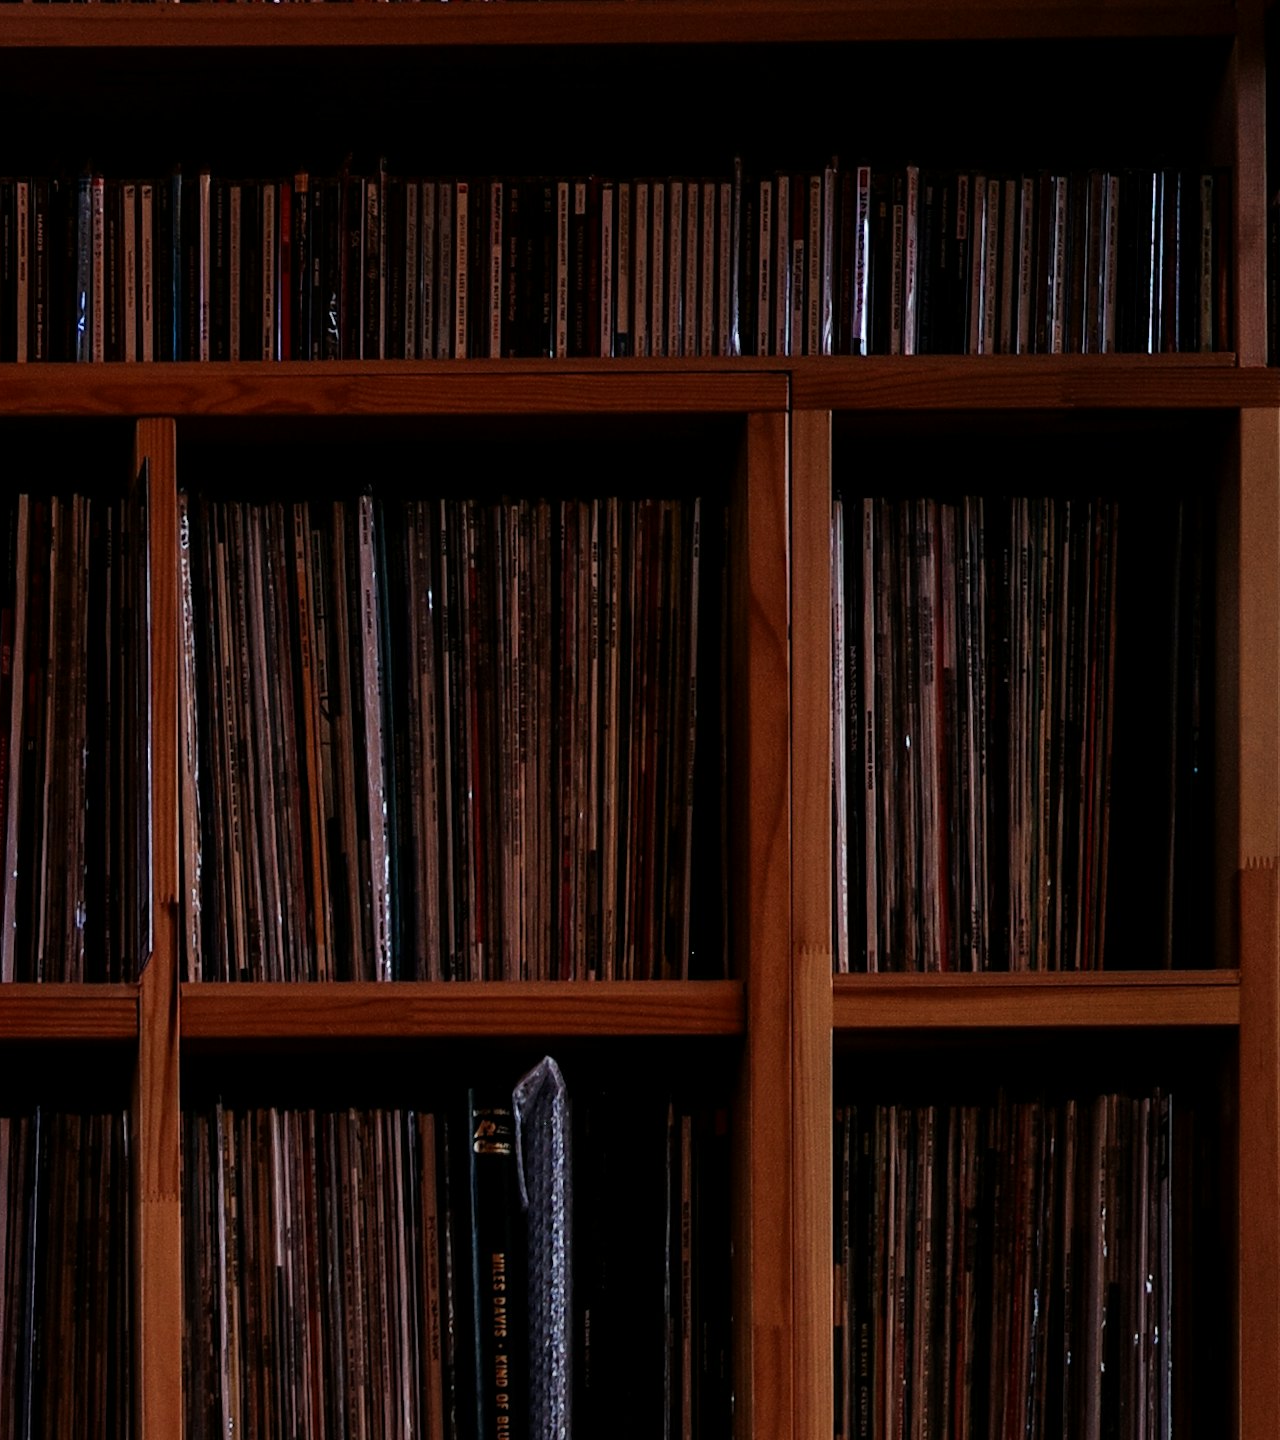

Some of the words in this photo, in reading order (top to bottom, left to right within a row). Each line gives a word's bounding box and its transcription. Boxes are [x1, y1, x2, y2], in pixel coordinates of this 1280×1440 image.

[490, 1252, 505, 1290] MILES
[491, 1296, 507, 1338] DAVIS
[493, 1354, 508, 1388] KIND
[494, 1392, 509, 1410] OF
